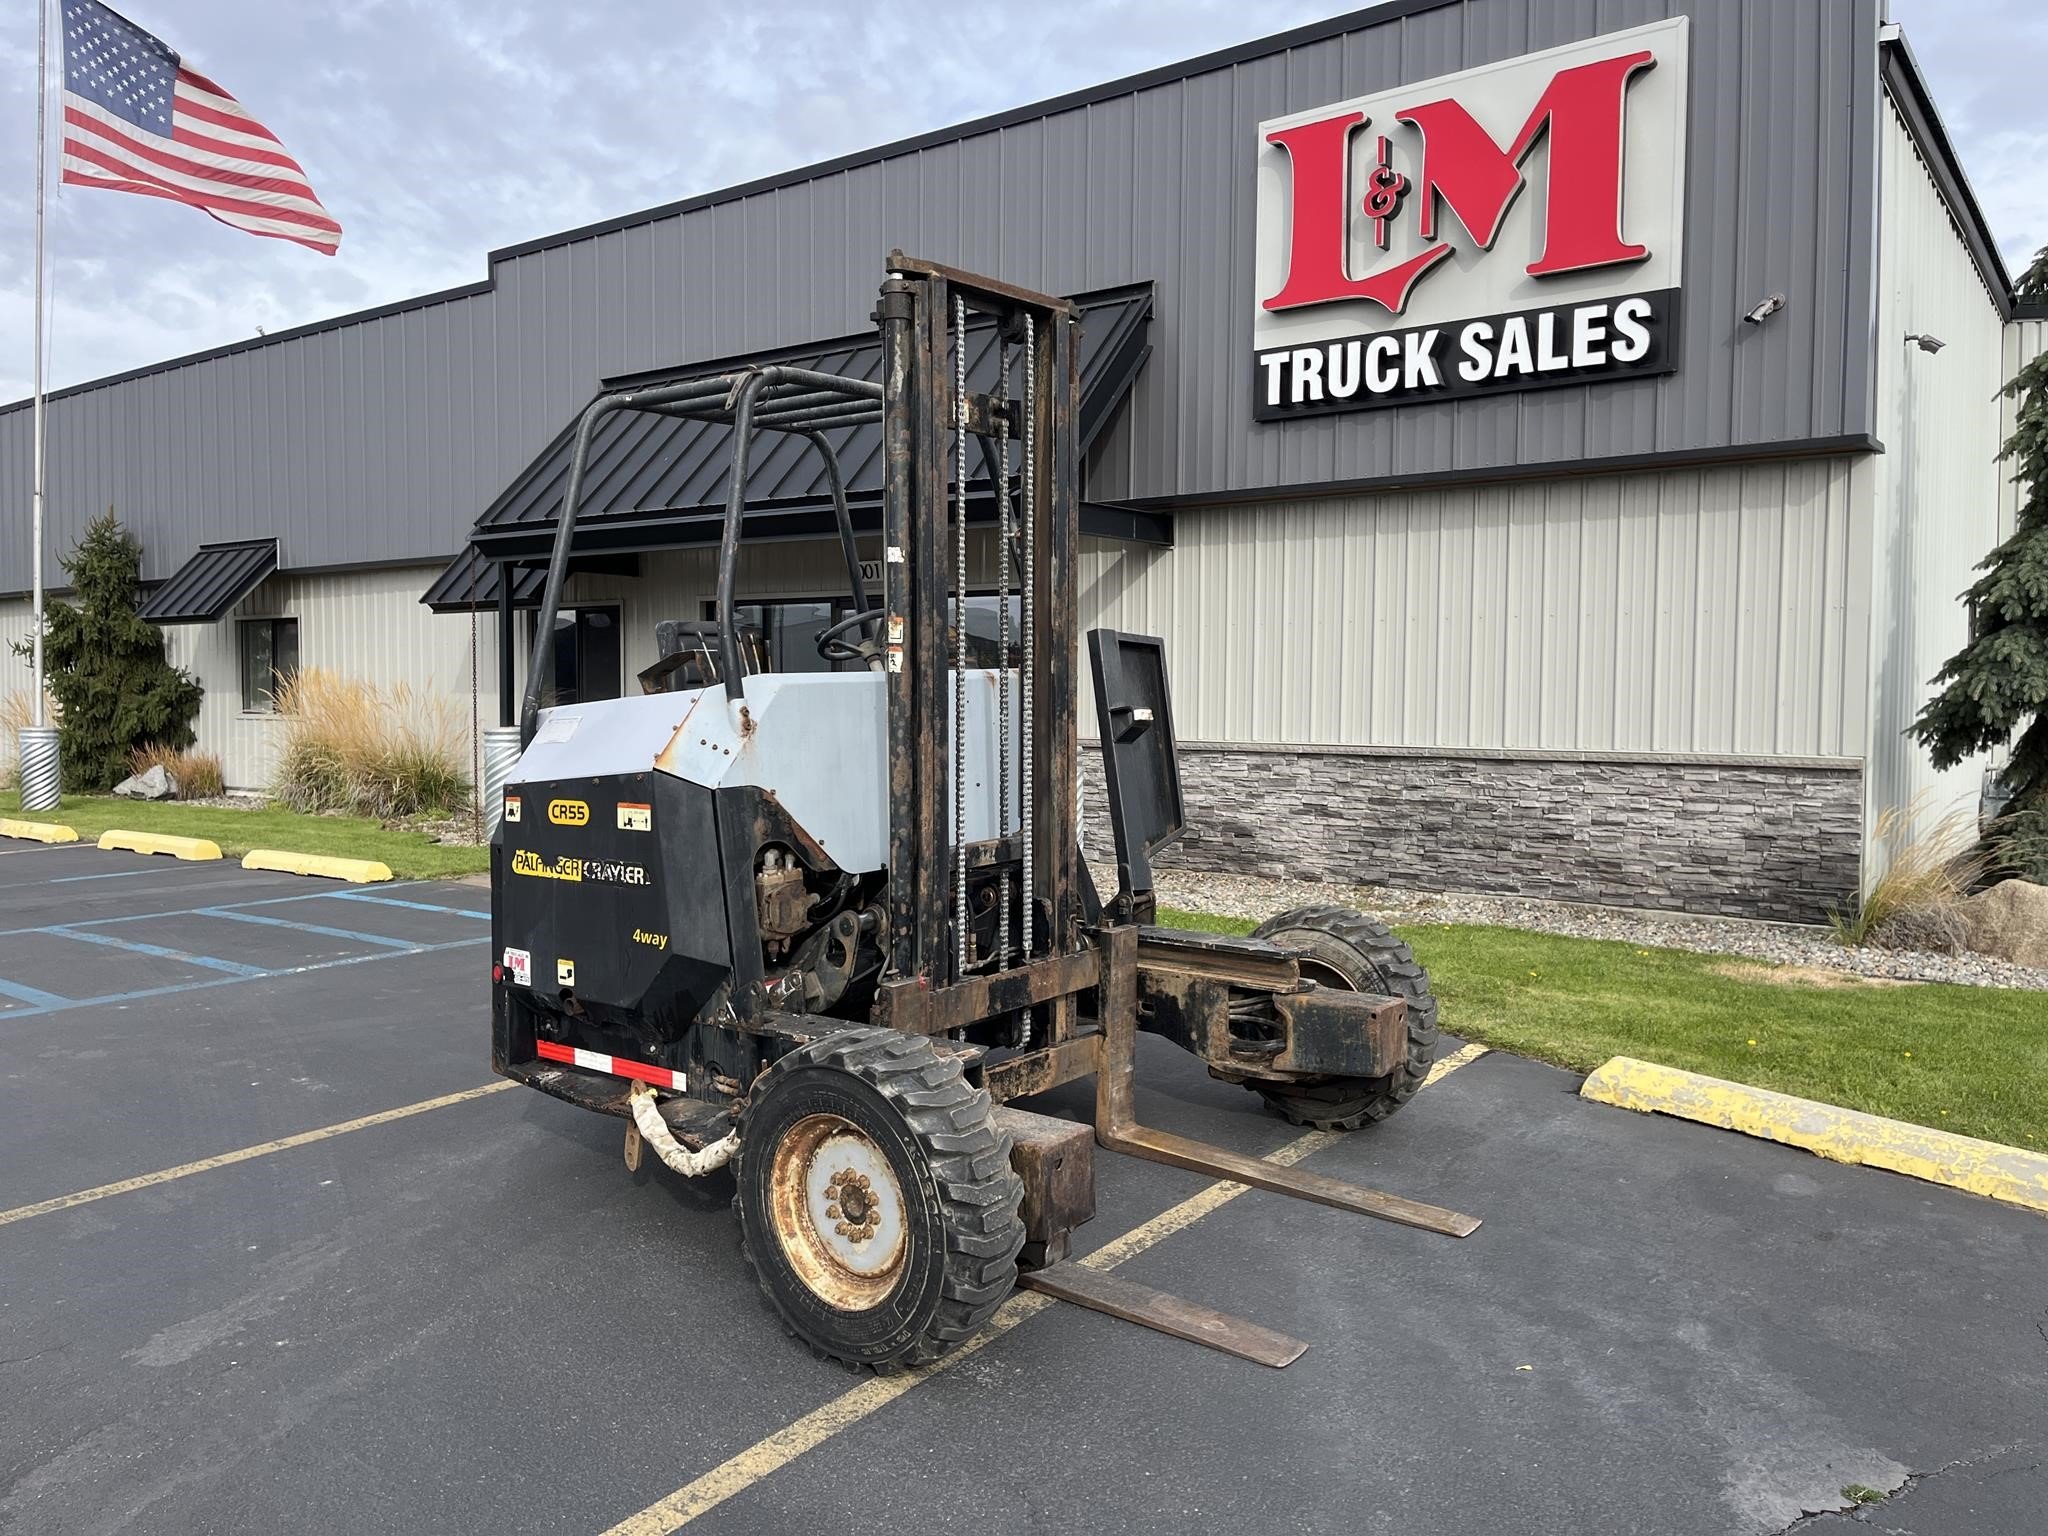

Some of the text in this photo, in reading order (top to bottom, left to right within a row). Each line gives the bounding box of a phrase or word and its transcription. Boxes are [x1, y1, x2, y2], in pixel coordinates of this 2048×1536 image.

[1262, 49, 1656, 314] L&M
[1260, 298, 1653, 406] TRUCK SALES
[551, 804, 586, 820] CR55
[632, 928, 668, 950] 4way
